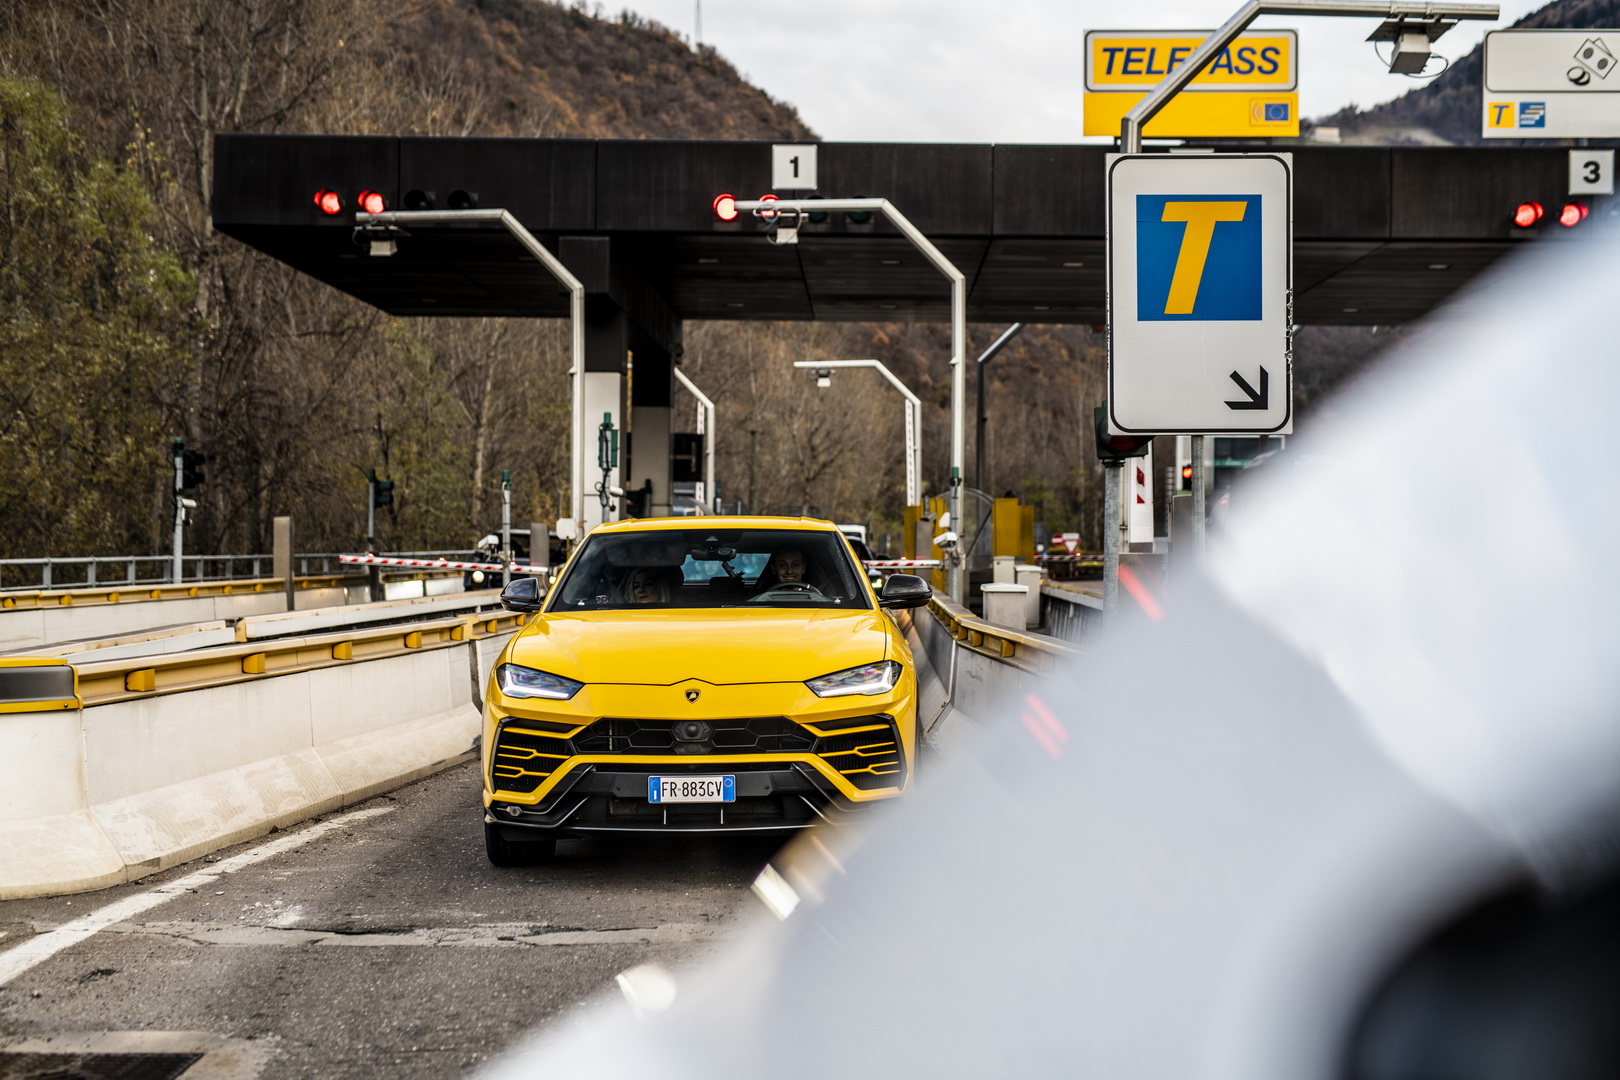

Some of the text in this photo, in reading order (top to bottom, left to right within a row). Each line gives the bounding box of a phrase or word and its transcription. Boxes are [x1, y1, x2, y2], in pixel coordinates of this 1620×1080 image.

[1102, 46, 1281, 75] TELEASS
[1493, 104, 1510, 125] T
[789, 156, 799, 178] 1
[1583, 160, 1601, 184] 3
[1161, 201, 1248, 314] T
